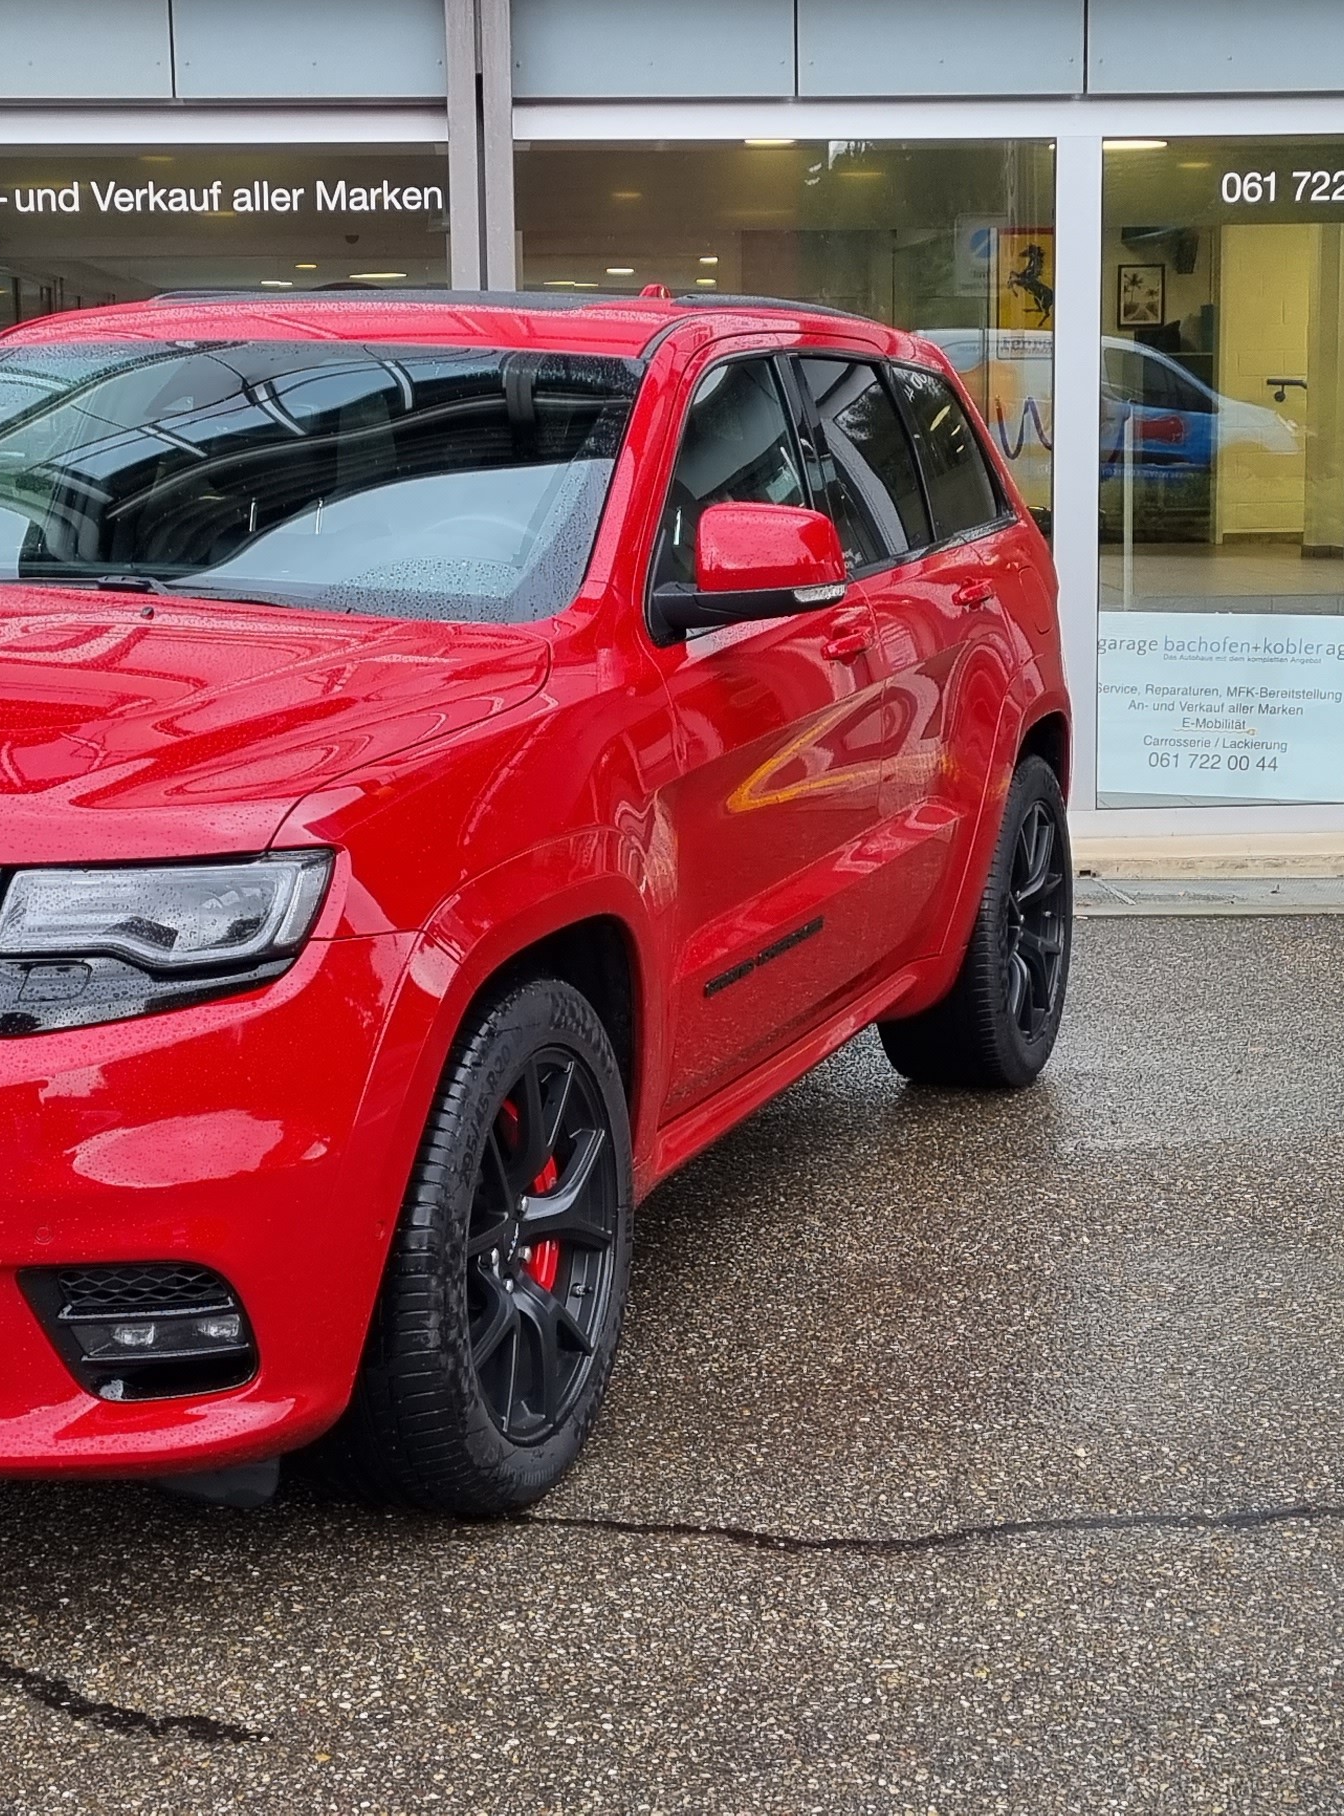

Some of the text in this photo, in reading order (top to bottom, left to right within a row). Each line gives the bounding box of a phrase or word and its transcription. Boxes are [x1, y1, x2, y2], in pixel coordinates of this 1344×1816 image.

[15, 182, 79, 212] und
[90, 181, 221, 211] Verkauf
[232, 181, 305, 210] aller
[315, 180, 442, 210] Marken
[1221, 171, 1276, 202] 061
[1097, 638, 1158, 656] garage
[1097, 683, 1342, 703] Service, Reparaturen, MFK-Bereitstellung
[1128, 699, 1304, 716] An- und Verkauf aller Marken
[1182, 717, 1247, 730] E-Mobilität
[1143, 734, 1211, 748] Carrosserie
[1222, 737, 1288, 753] Lackierung
[1148, 752, 1279, 772] 061 722 00 44
